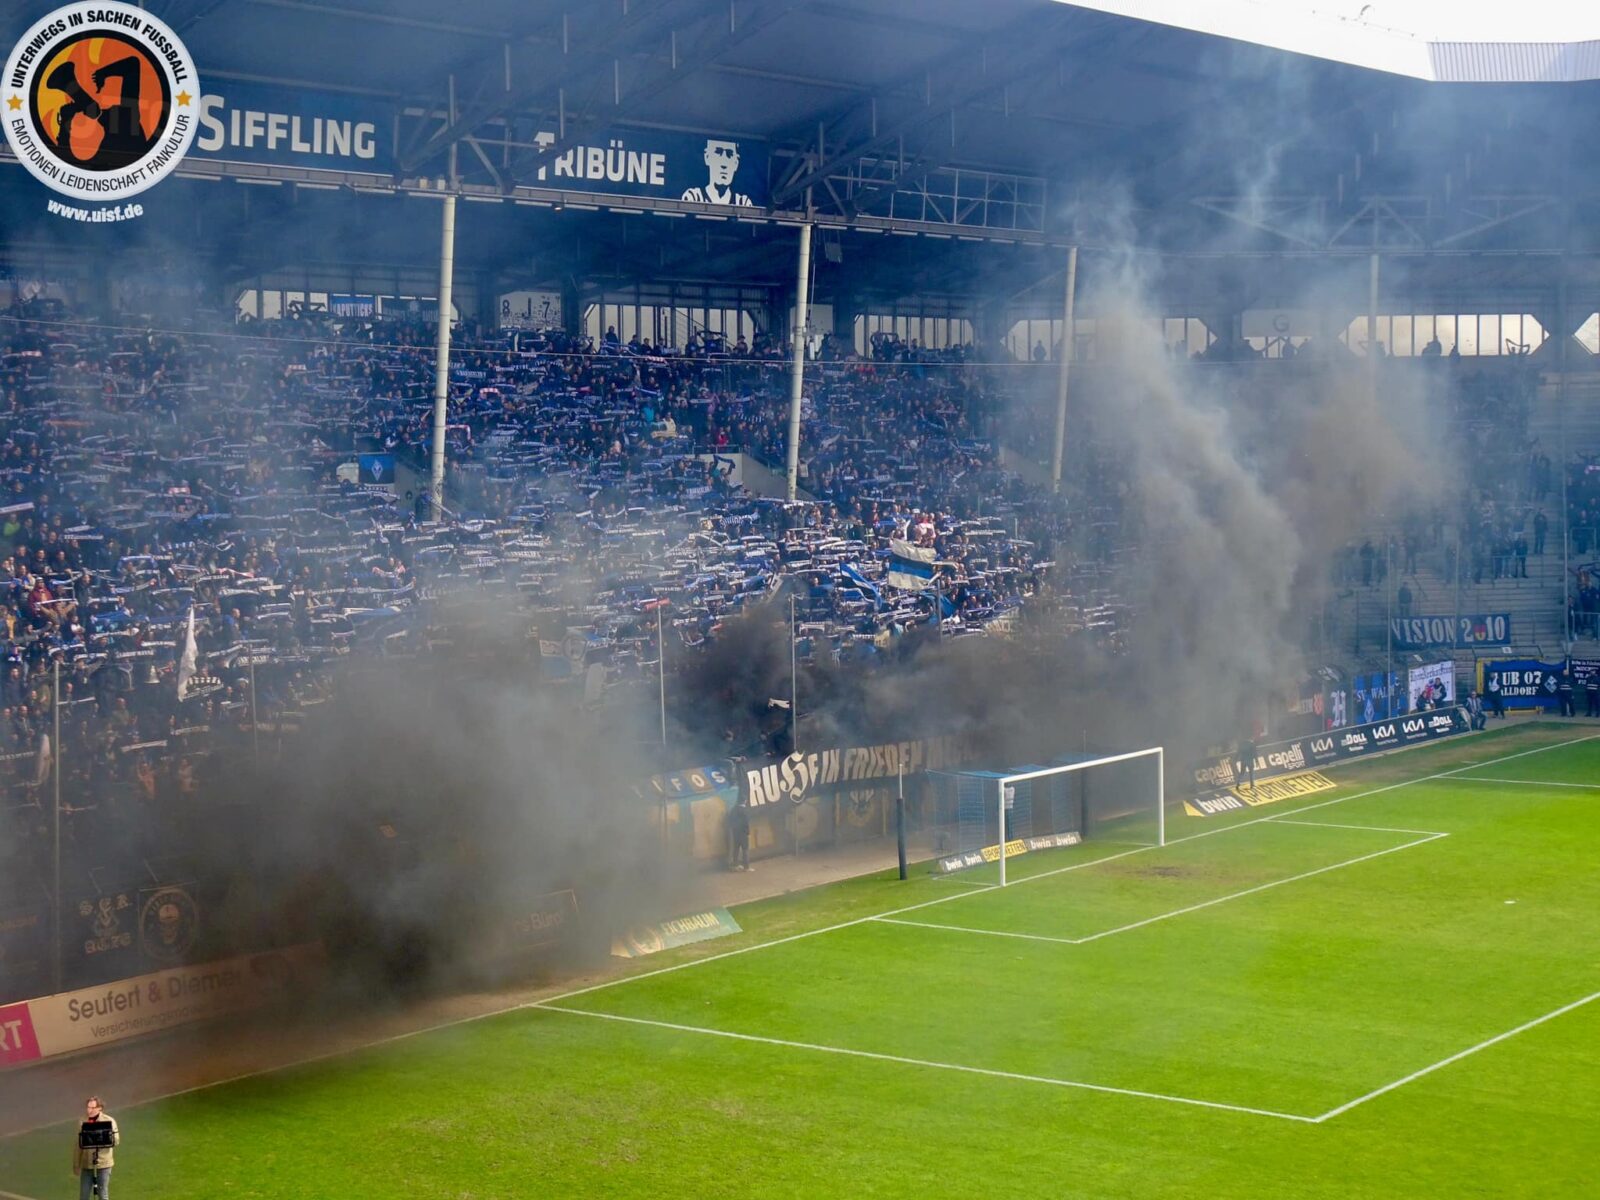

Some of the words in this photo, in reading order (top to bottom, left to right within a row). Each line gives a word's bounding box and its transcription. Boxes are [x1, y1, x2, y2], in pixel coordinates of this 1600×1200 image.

[197, 94, 375, 159] SIFFLING
[534, 131, 665, 186] TRIBÜNE
[1391, 618, 1457, 643] VISION
[1524, 670, 1543, 685] 07
[820, 748, 840, 785] IN
[841, 740, 923, 781] FRIEDEN
[1194, 756, 1234, 785] capelli
[1268, 742, 1305, 768] capelli
[1287, 760, 1305, 770] SPORT
[1194, 793, 1244, 814] bwin
[1238, 771, 1333, 804] SPORTWETTEN
[945, 857, 964, 870] bwin
[964, 853, 982, 866] bwin
[1030, 839, 1052, 851] bwin
[1056, 836, 1077, 847] bwin
[660, 911, 720, 936] EICHBAUM
[69, 985, 141, 1022] Seufert
[148, 981, 161, 1003] &
